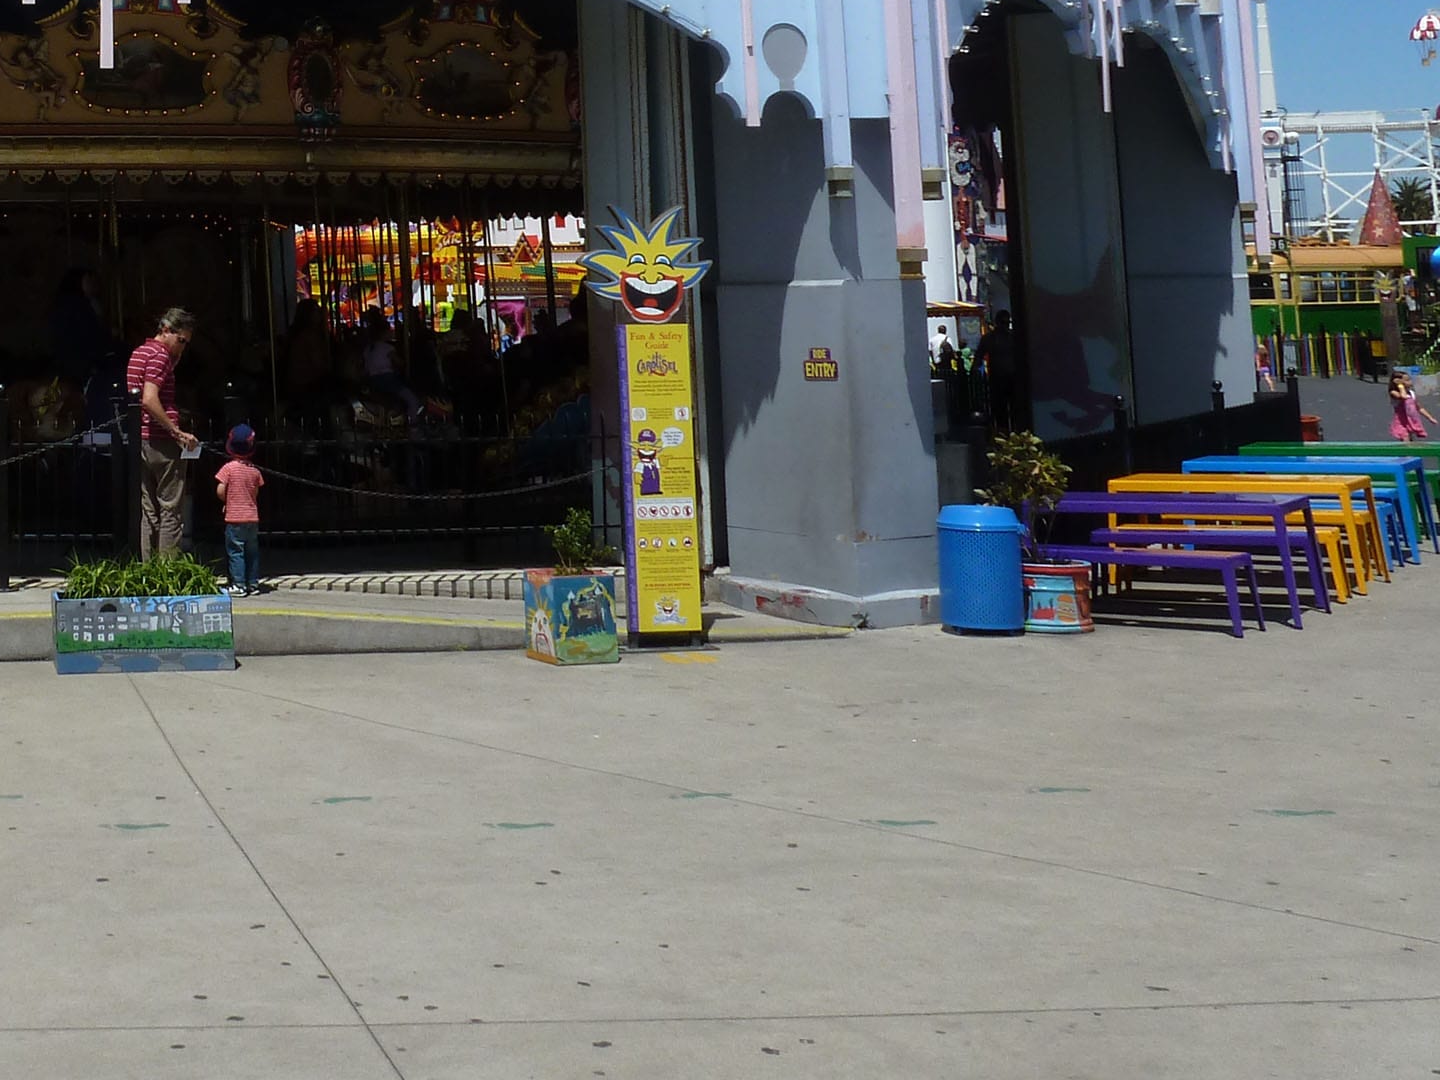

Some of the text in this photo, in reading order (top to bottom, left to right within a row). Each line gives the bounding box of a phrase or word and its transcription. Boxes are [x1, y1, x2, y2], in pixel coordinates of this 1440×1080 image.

[630, 331, 646, 341] Fun
[659, 331, 682, 343] Safety
[645, 340, 669, 350] Guide
[805, 362, 836, 378] ENTRY
